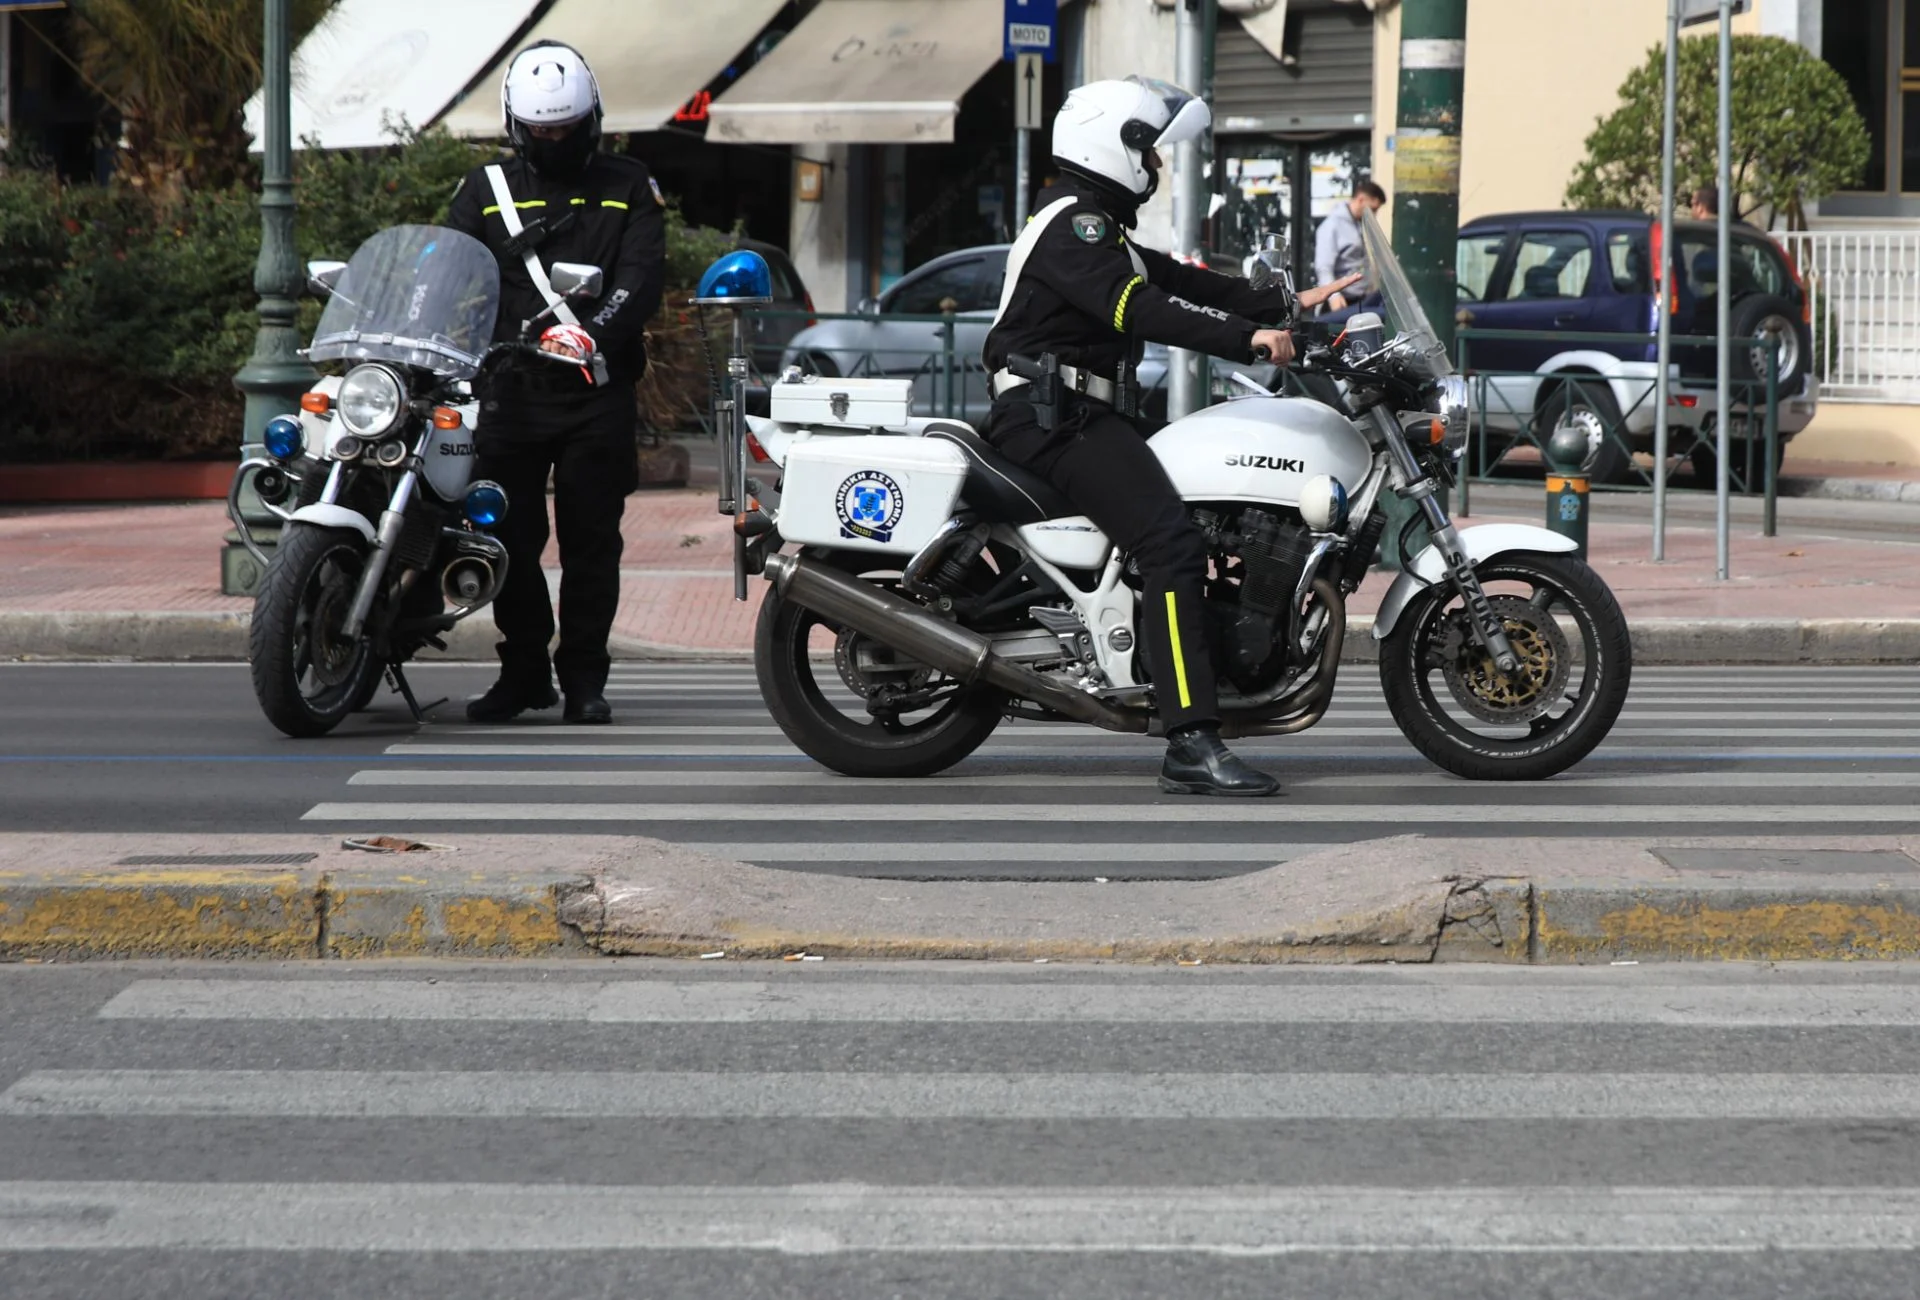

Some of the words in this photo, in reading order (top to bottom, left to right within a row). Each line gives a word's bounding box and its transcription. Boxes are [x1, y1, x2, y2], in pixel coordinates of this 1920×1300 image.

[1013, 28, 1046, 42] MOTO
[592, 288, 630, 326] POLICE
[439, 443, 474, 456] SUZU
[1224, 454, 1304, 473] SUZUKI
[836, 472, 867, 524] ΕΛΛΗΝΙΚΗ
[869, 472, 903, 528] ΑΣΤΥΝΟΜΙΑ
[1447, 551, 1501, 638] SUZUKI
